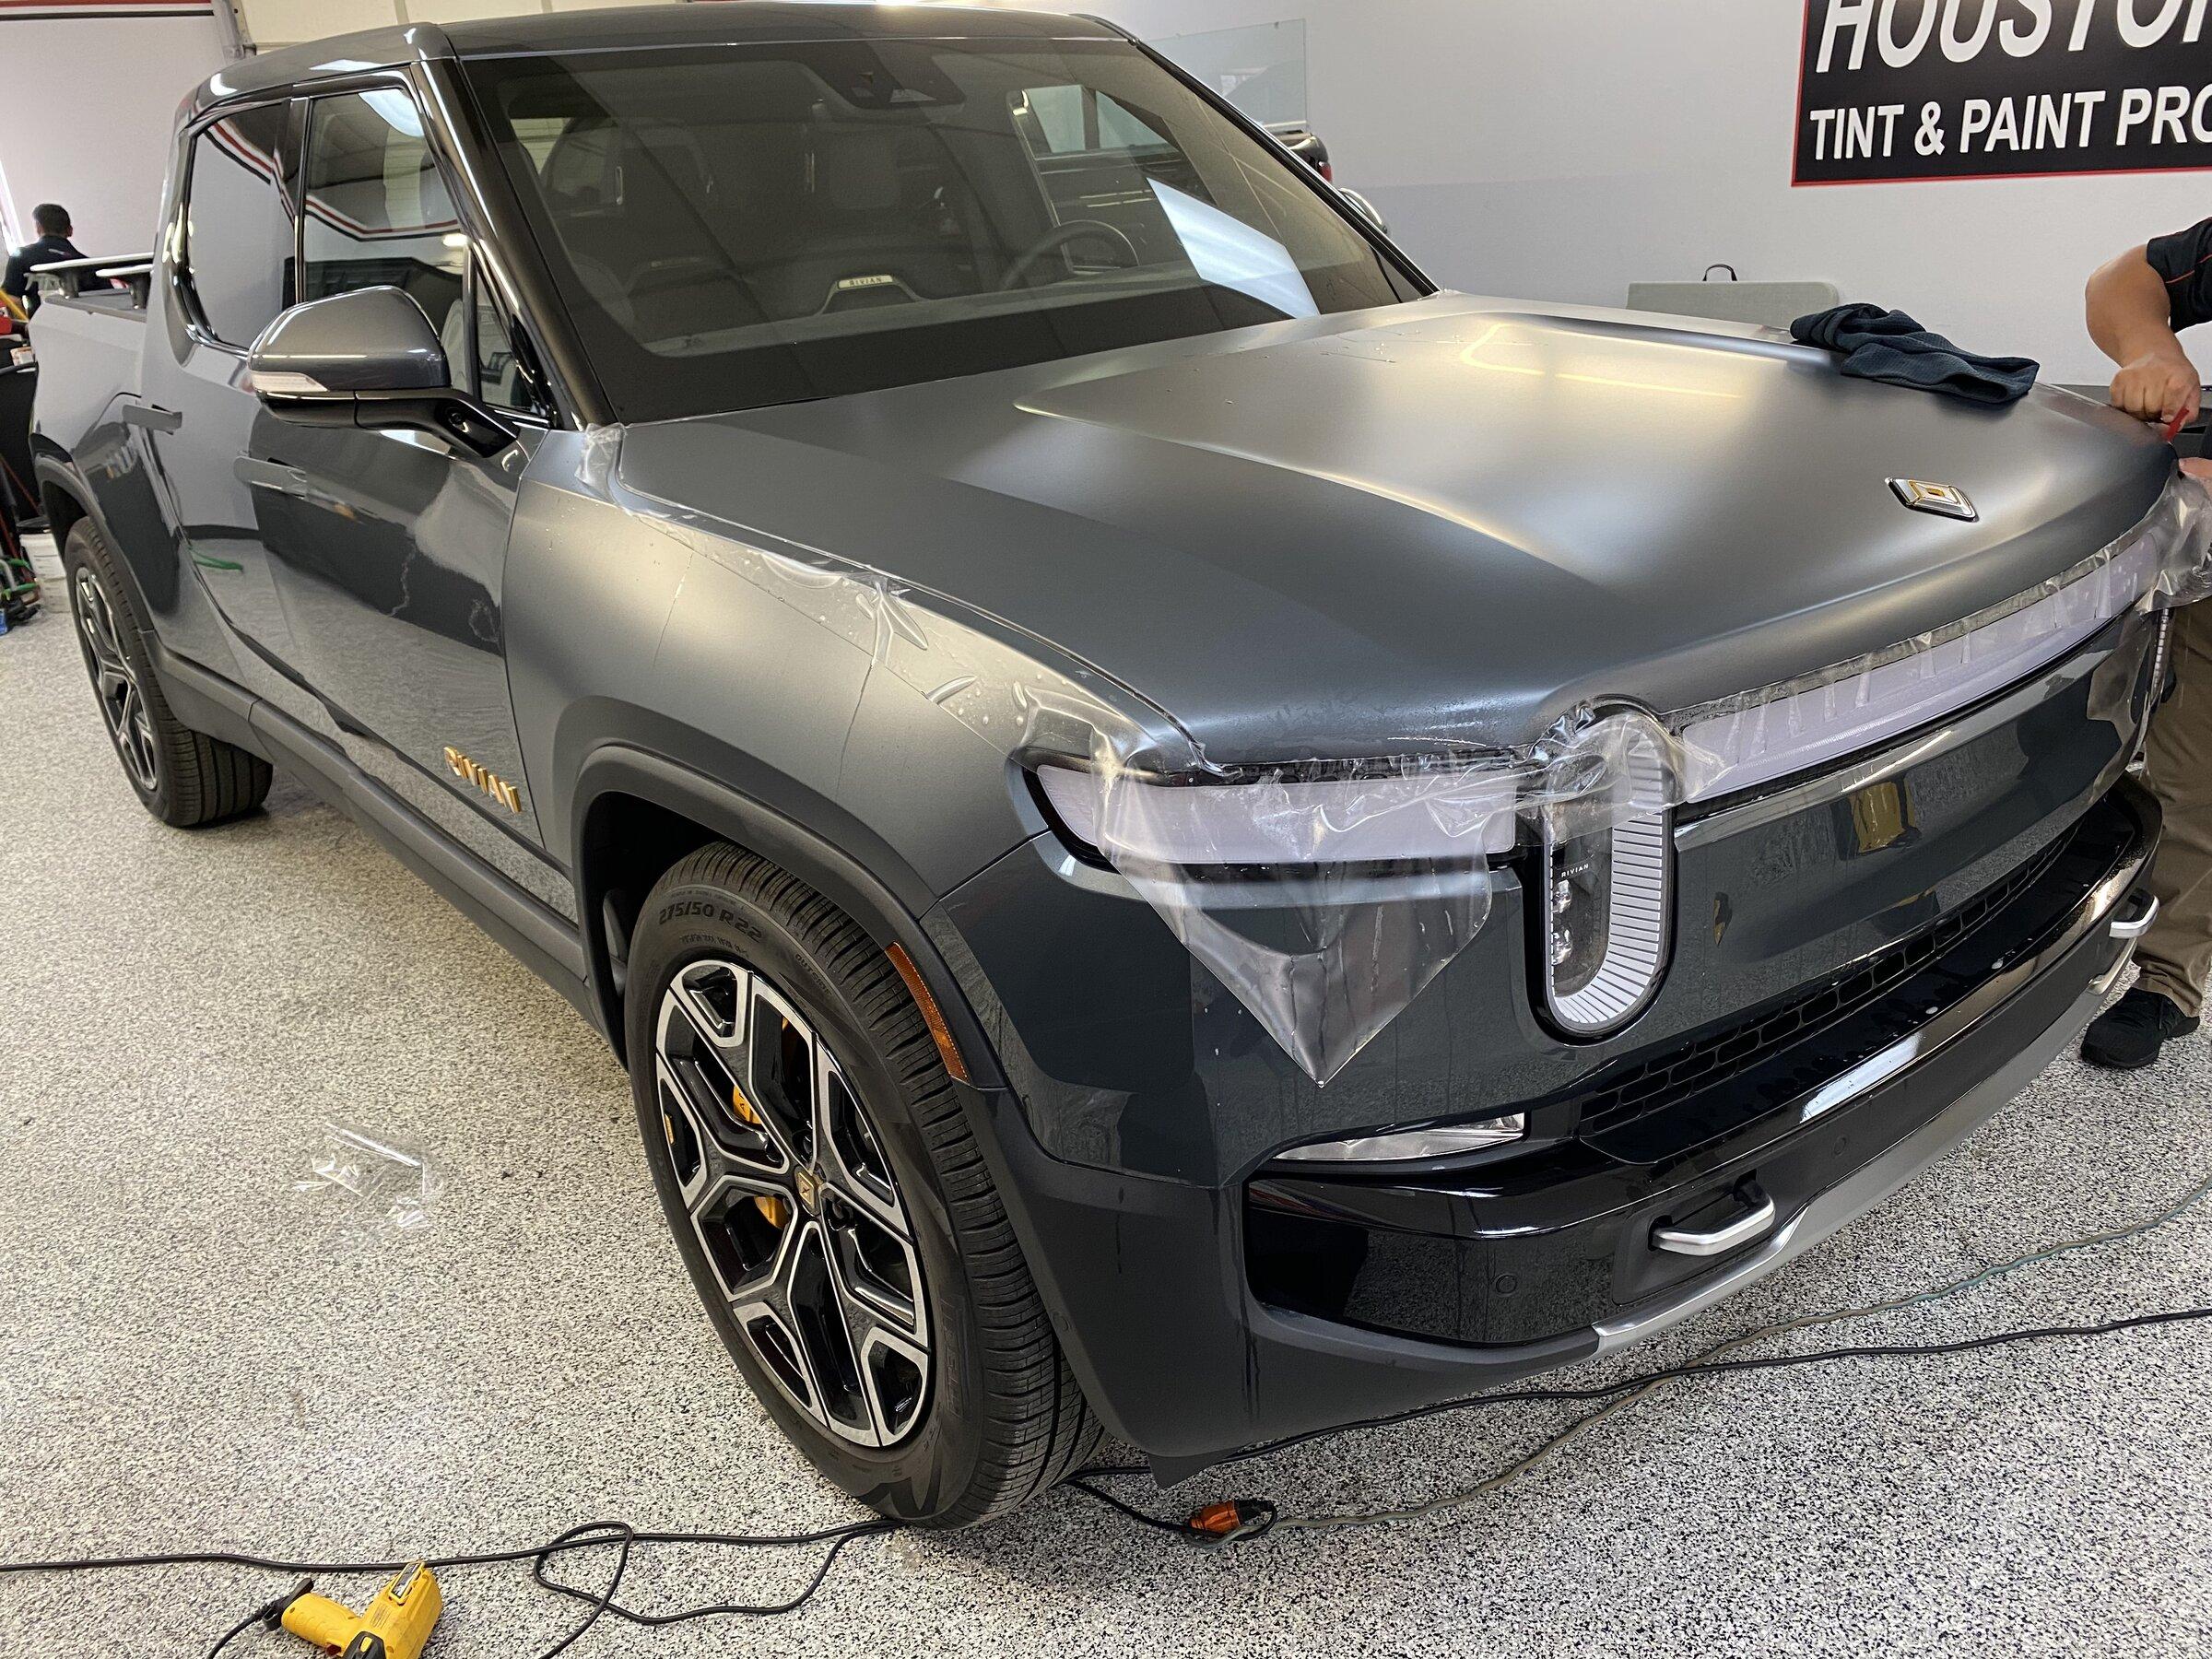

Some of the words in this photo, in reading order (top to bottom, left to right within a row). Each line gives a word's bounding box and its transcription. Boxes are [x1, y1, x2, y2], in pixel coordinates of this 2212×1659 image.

[1816, 0, 2212, 73] HOUS
[1809, 104, 1904, 160] TINT
[1914, 100, 1946, 156] &
[1959, 90, 2106, 153] PAINT
[1560, 863, 1589, 878] RIVIAN
[659, 900, 715, 925] 275/50
